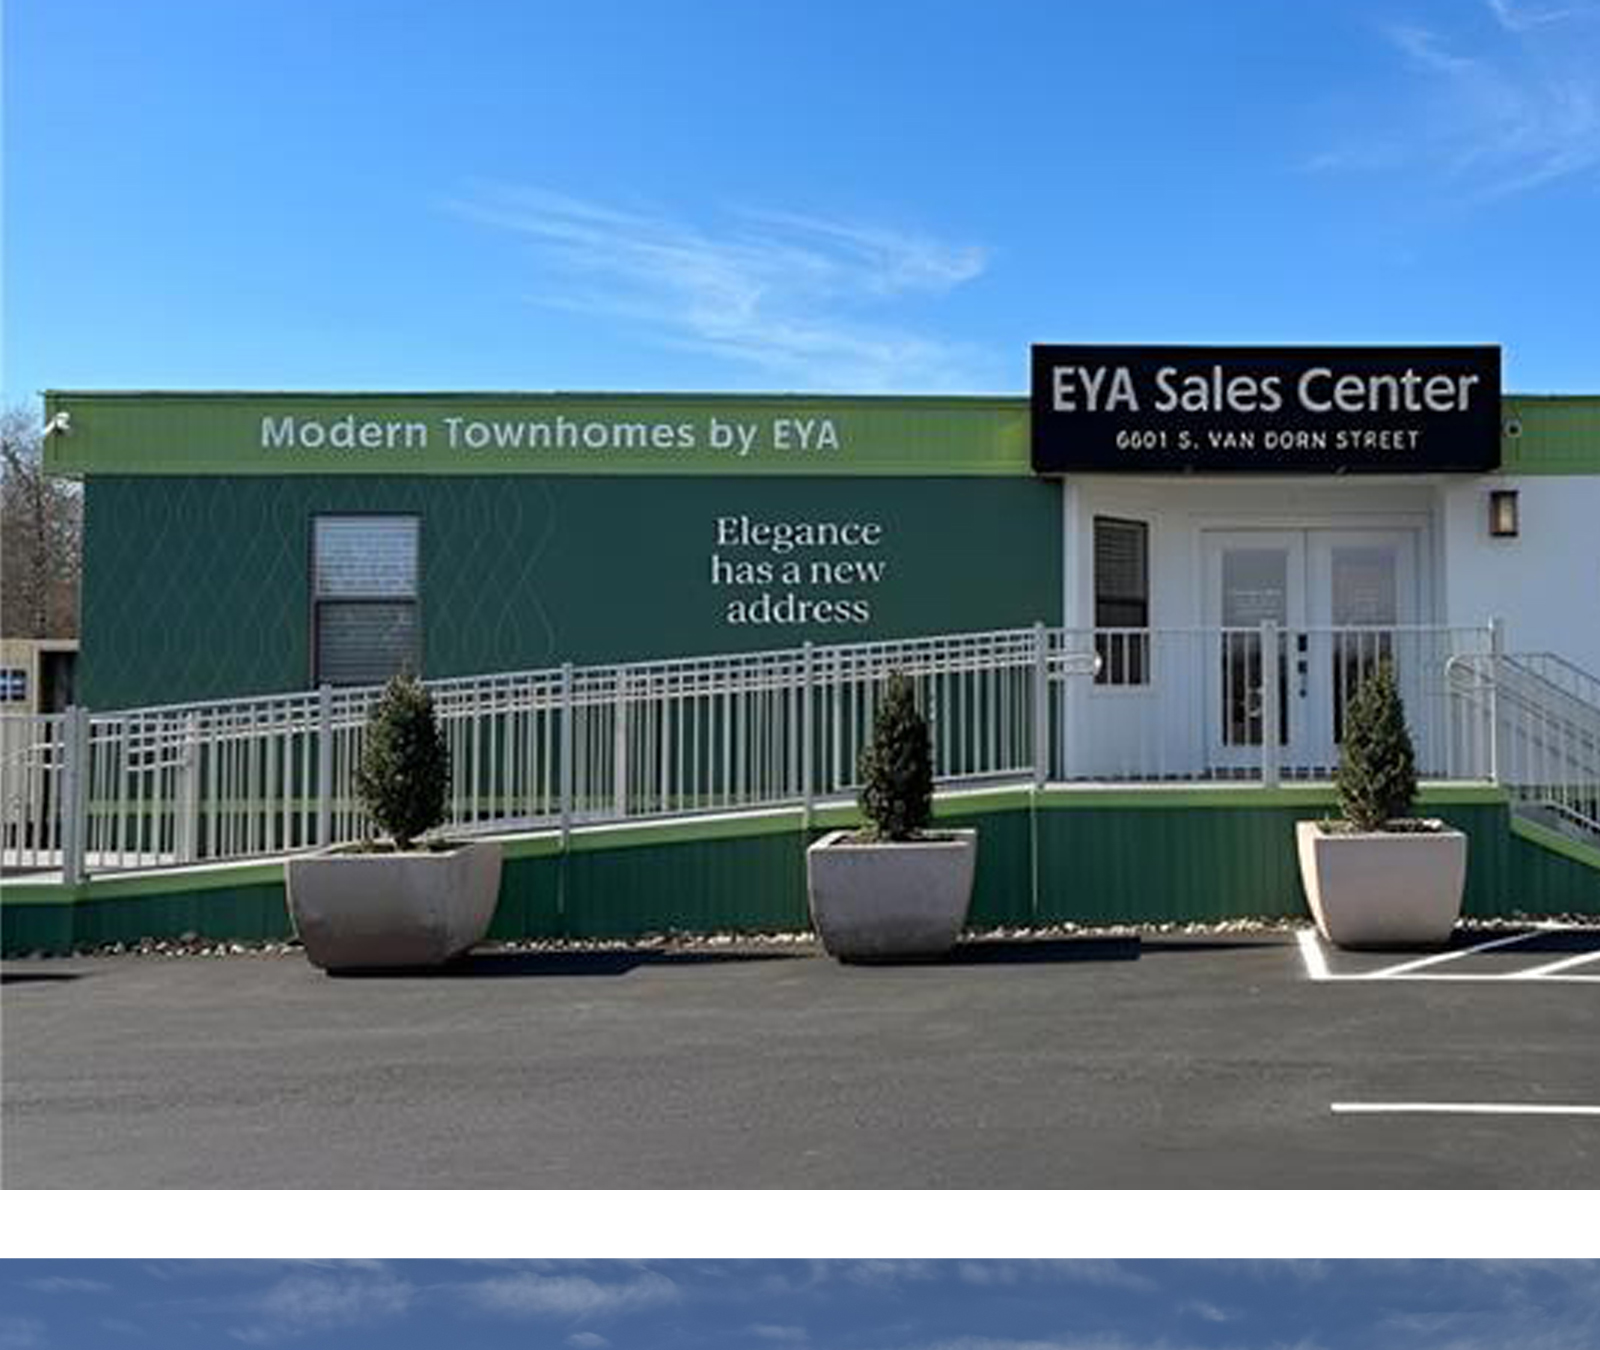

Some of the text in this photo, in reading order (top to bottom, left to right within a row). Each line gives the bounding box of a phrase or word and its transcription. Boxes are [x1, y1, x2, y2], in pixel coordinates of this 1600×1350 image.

[1052, 365, 1479, 411] EYA Sales Center
[260, 415, 841, 455] Modern Townhomes by EYA
[1178, 430, 1198, 449] S.
[1208, 430, 1255, 449] VAN
[1264, 430, 1327, 449] DORN
[1336, 430, 1419, 449] STREET
[717, 516, 881, 553] Elegance
[712, 554, 886, 585] has a new
[727, 593, 870, 624] address
